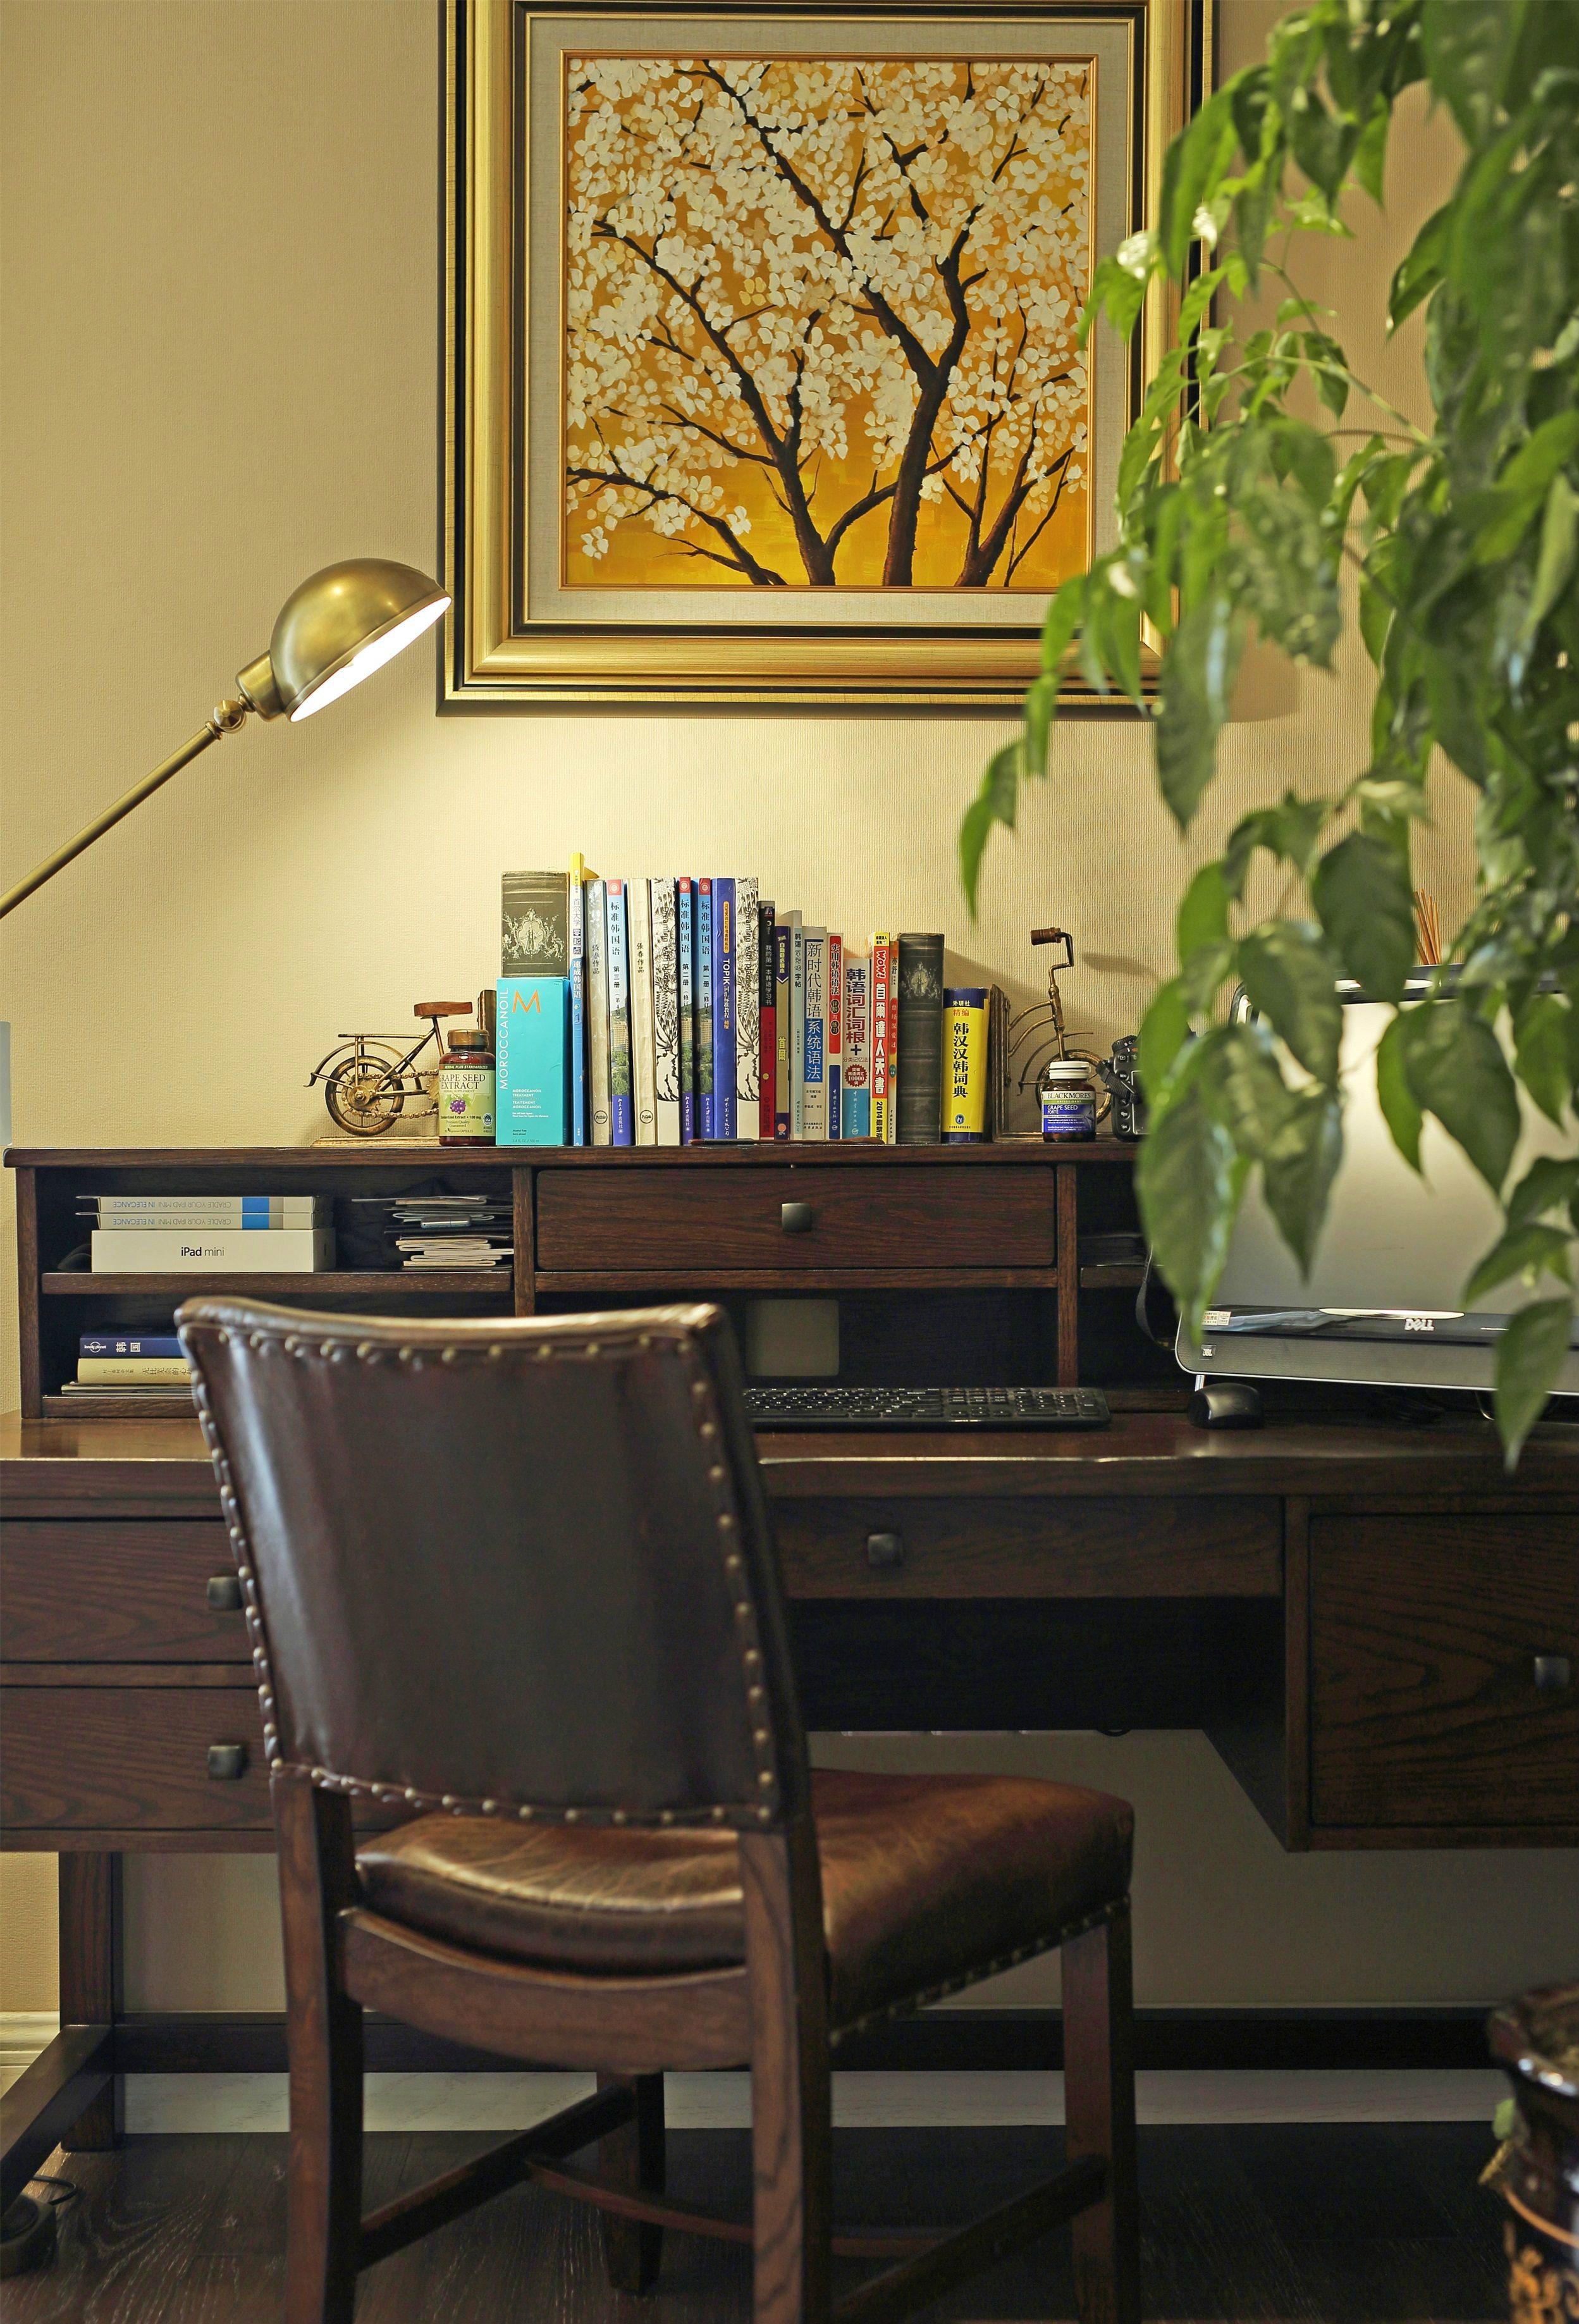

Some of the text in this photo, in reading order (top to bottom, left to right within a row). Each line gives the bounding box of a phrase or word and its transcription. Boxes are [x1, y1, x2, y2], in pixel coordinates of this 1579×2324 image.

[611, 901, 620, 956] 标准韩国语
[680, 899, 690, 953] 标准韩国语
[701, 901, 710, 955] 标准韩国语
[831, 944, 840, 996] 实用韩语语法
[876, 950, 886, 979] WOW!
[512, 989, 541, 1013] M
[807, 943, 822, 1079] 新时代韩语 系统语法
[952, 1008, 969, 1017] 精编
[500, 987, 508, 1089] MOROCCANOIL
[875, 982, 886, 1094] 首爾達人天書
[952, 1022, 969, 1098] 韩汉汉韩词典
[462, 1073, 486, 1082] SEED
[181, 1247, 224, 1256] iPad mini
[116, 1342, 141, 1353] 韩国
[1404, 1318, 1434, 1331] DELL
